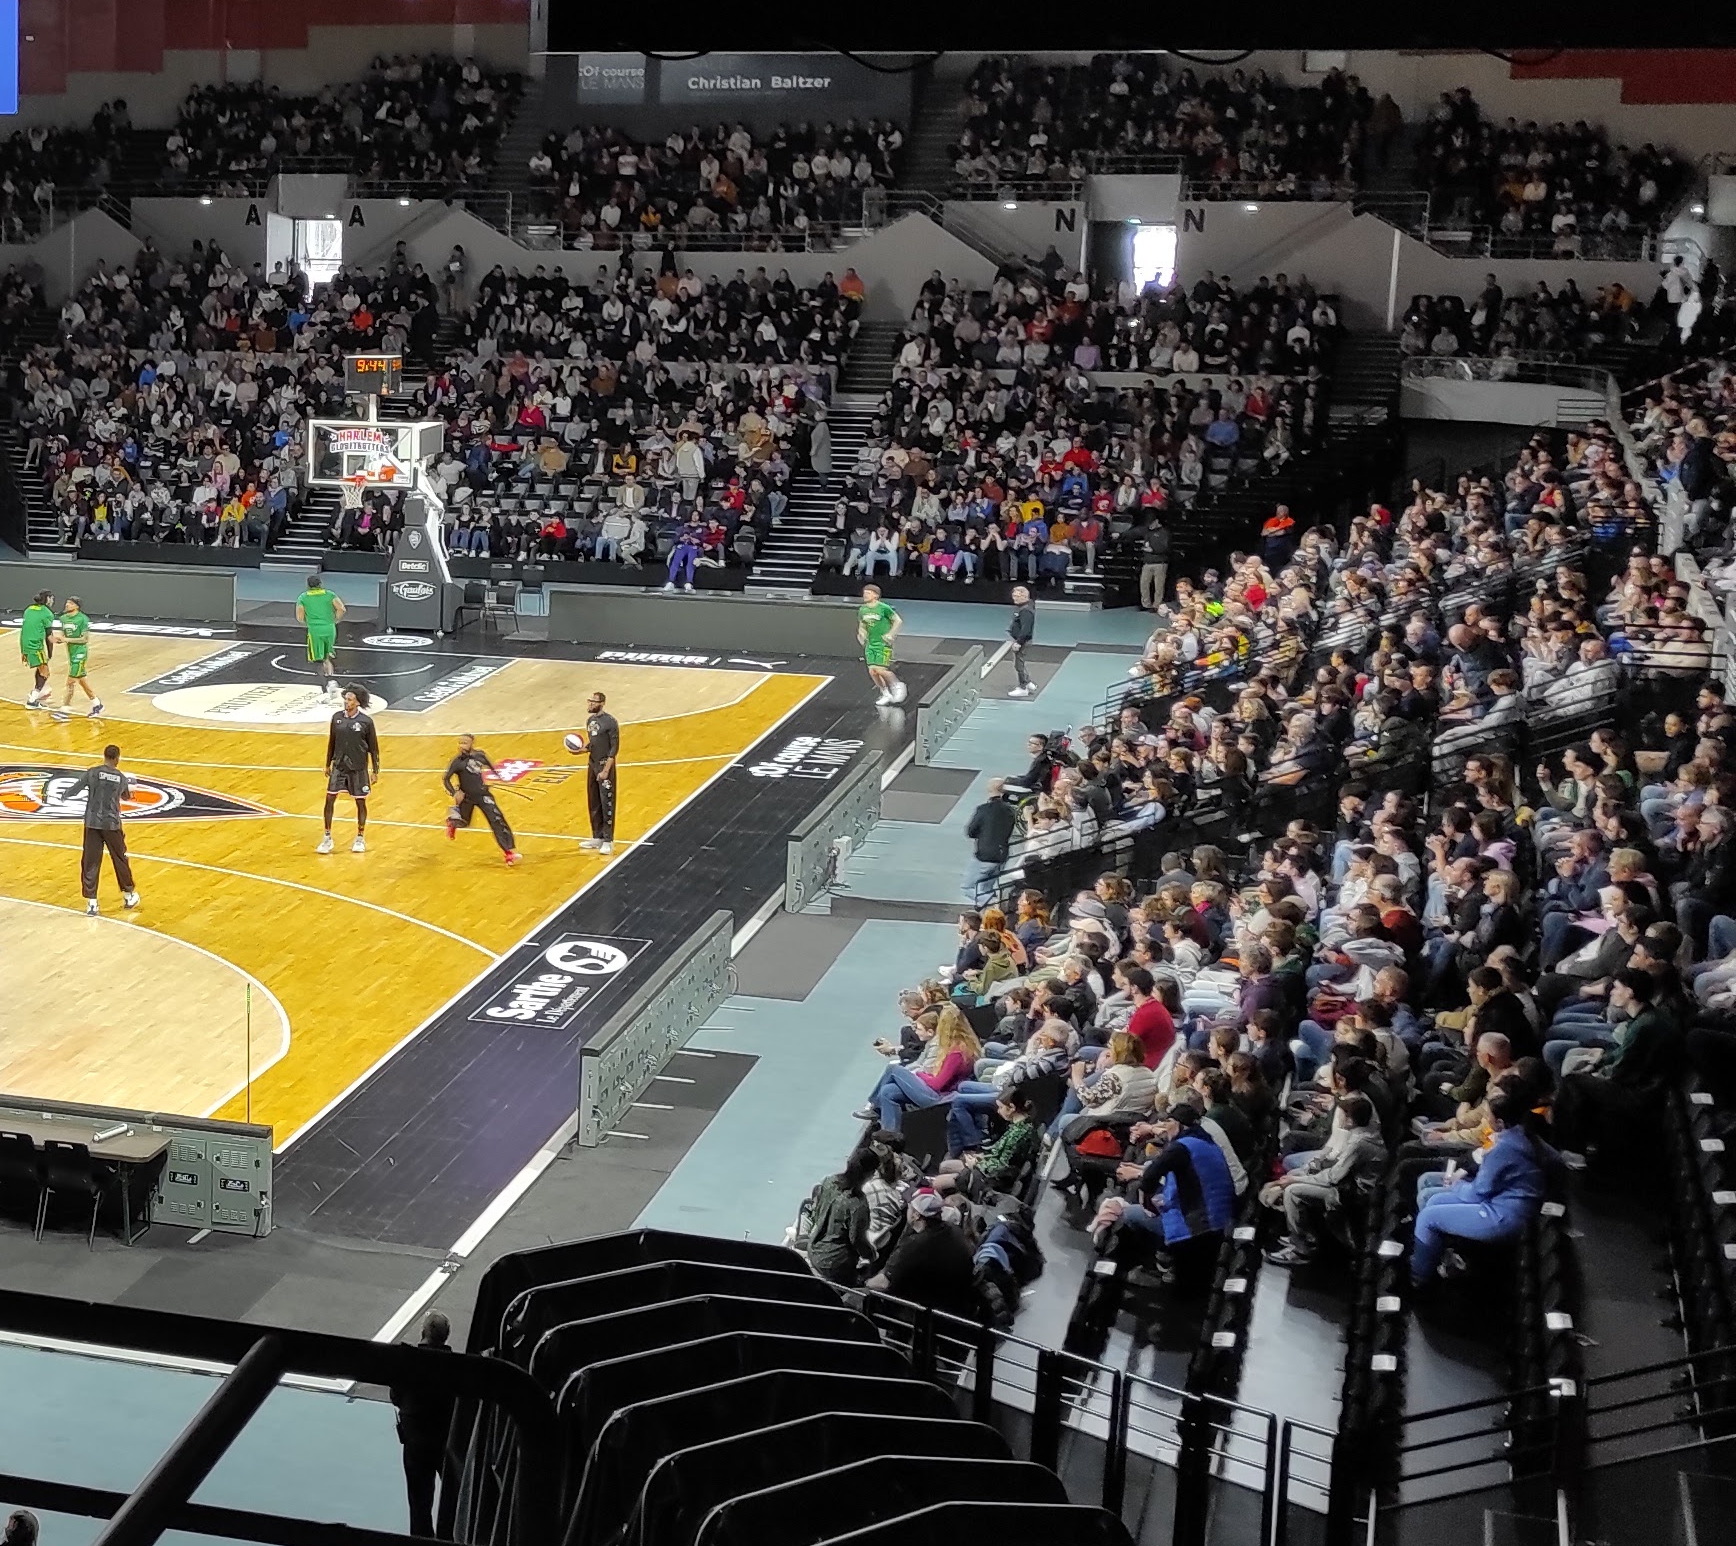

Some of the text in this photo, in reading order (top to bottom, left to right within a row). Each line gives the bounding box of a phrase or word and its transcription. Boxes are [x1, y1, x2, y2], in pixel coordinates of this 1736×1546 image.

[602, 67, 645, 77] course
[688, 75, 831, 90] Christian Baltzer
[604, 77, 645, 90] MANS
[245, 204, 261, 226] A
[349, 205, 365, 227] A
[1055, 208, 1075, 232] N
[1183, 208, 1205, 233] N
[356, 360, 387, 372] 9:44
[339, 429, 383, 443] HARLEM
[776, 736, 822, 769] course
[789, 738, 864, 779] LE MANS
[485, 973, 575, 1021] Sarthe
[535, 1013, 559, 1024] Le
